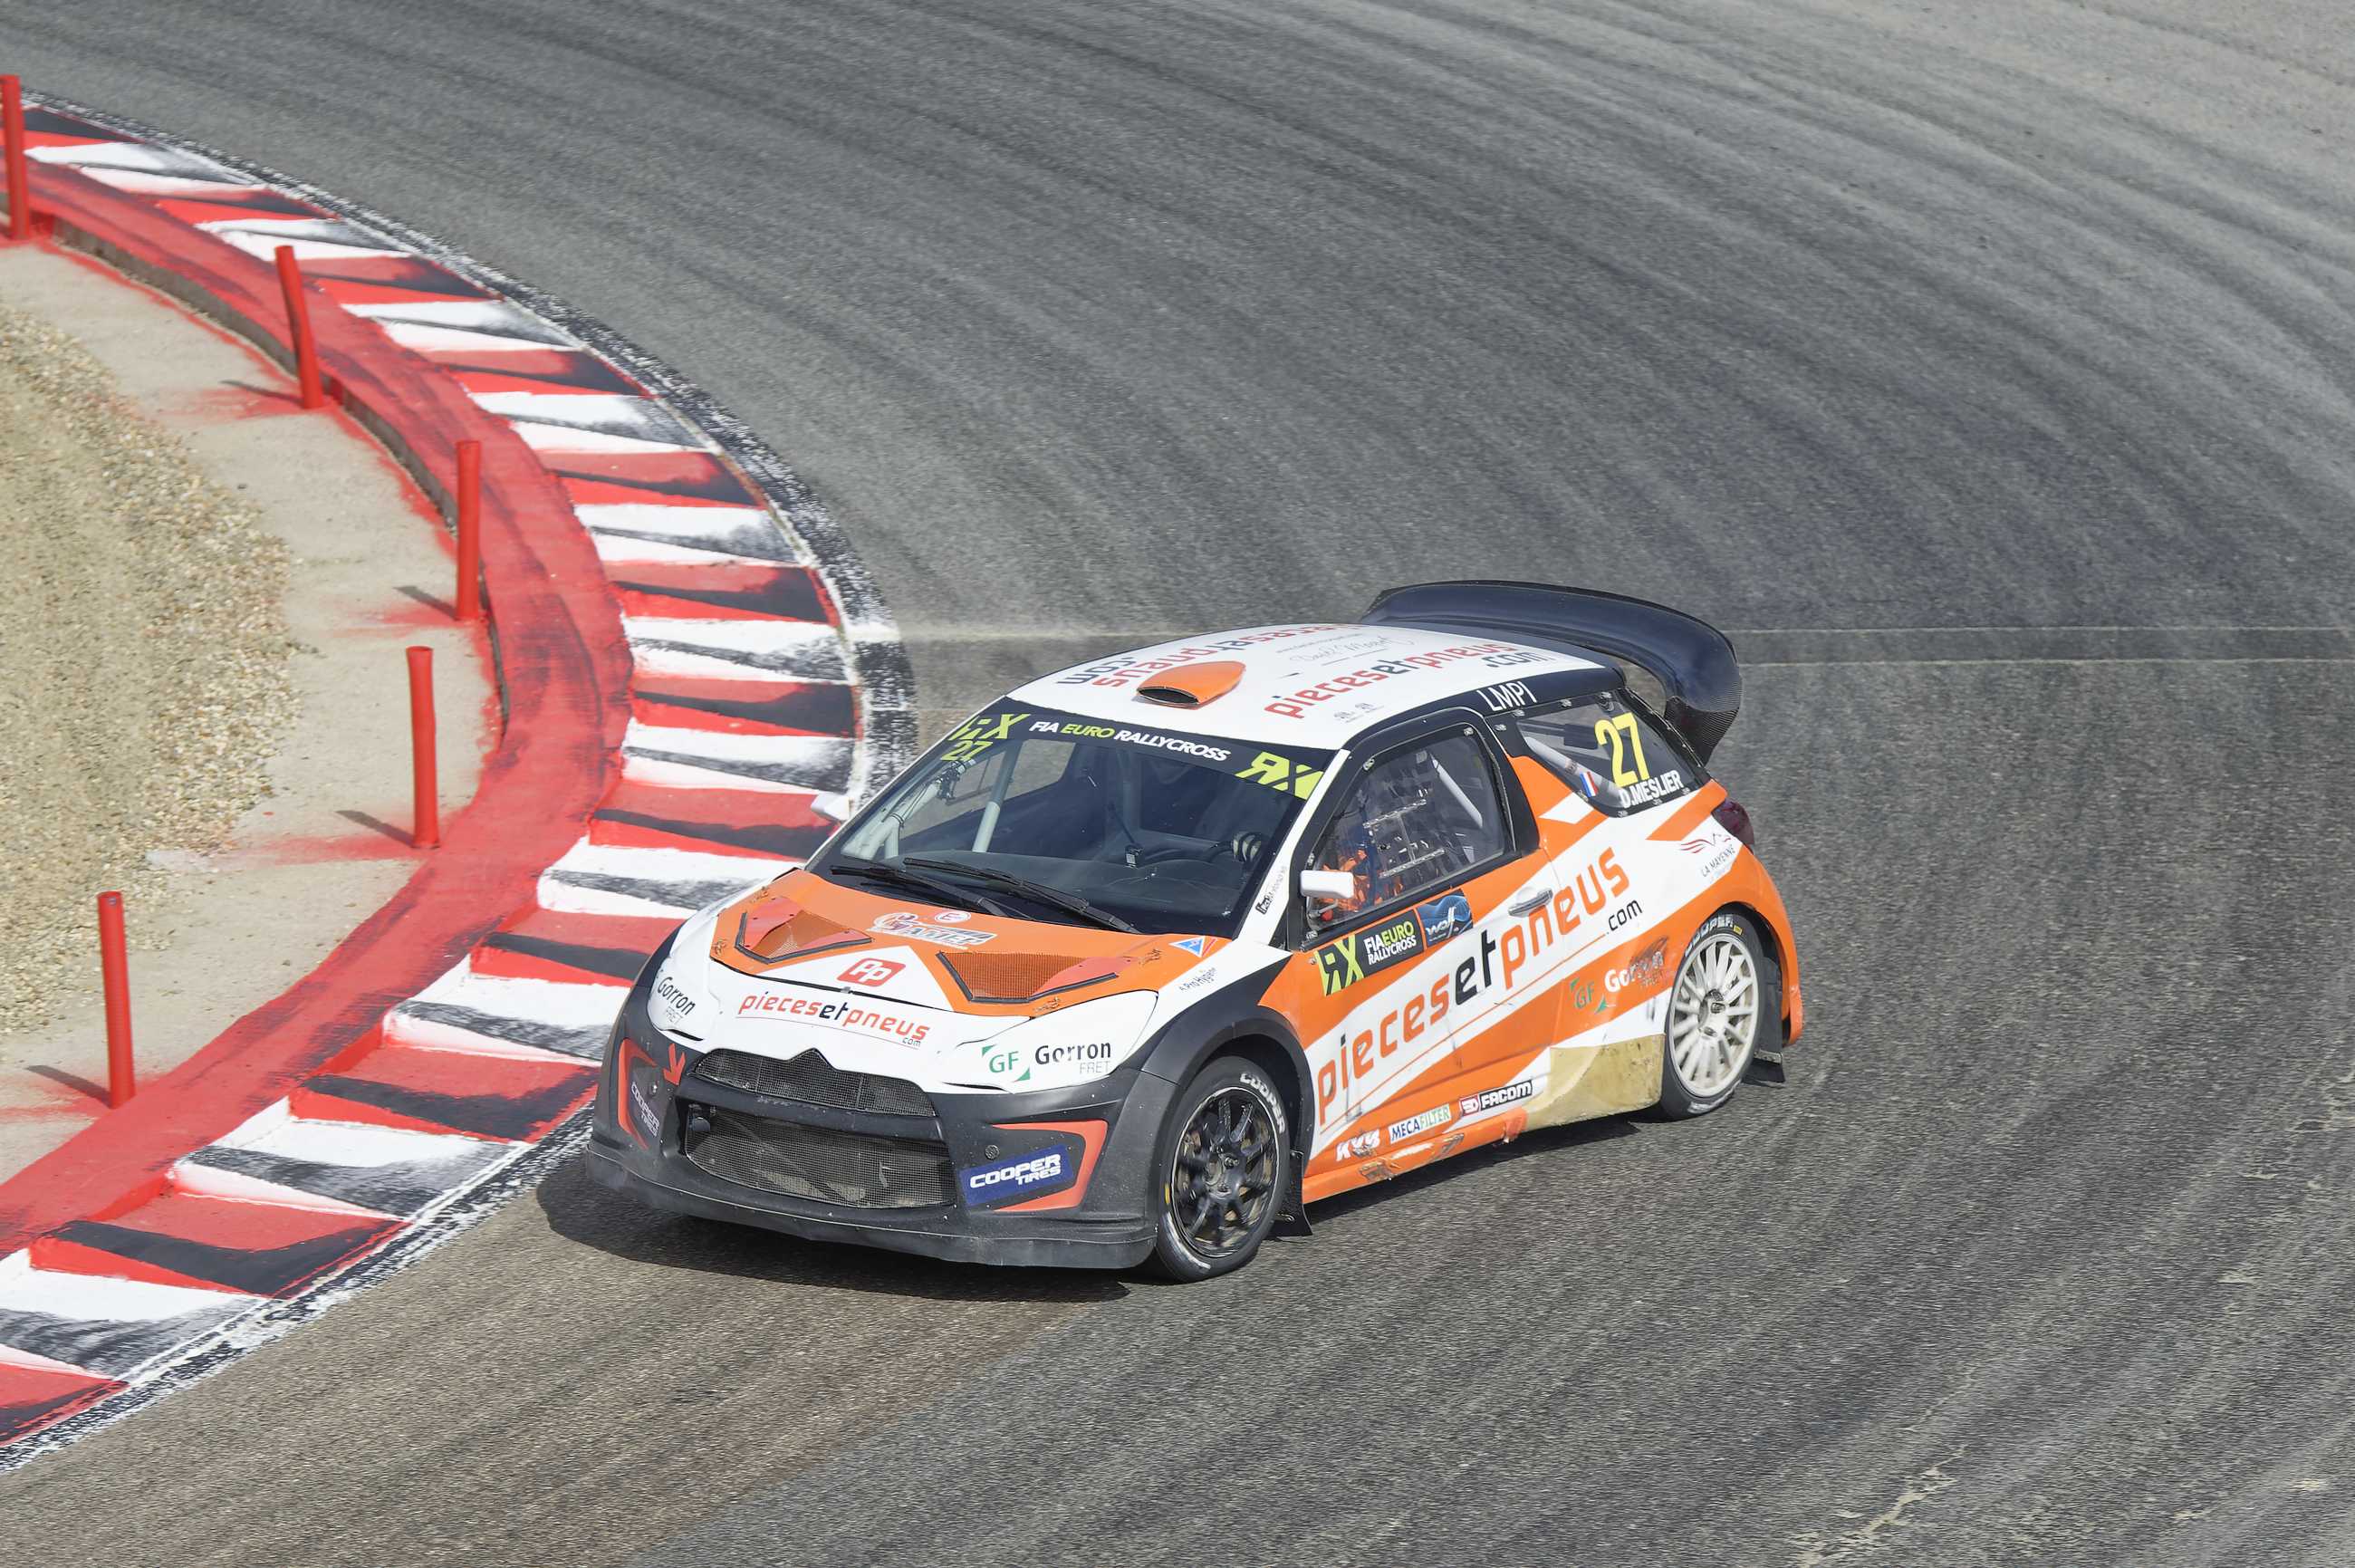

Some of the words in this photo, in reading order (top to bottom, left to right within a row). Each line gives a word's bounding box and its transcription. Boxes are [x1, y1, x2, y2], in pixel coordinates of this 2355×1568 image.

[1264, 643, 1518, 719] piecesetpneus
[1476, 679, 1537, 712] LMPI
[940, 740, 994, 761] 27
[1029, 721, 1060, 733] FIA
[1061, 724, 1115, 738] EURO
[1113, 729, 1232, 762] RALLYCROSS
[1594, 712, 1650, 788] 27
[1367, 935, 1418, 966] RALLYCROSS
[657, 976, 697, 1015] Gorron
[1317, 847, 1629, 1126] piecesetpneus
[738, 991, 930, 1042] piecesetpneus
[988, 1050, 1020, 1073] GF
[1034, 1042, 1111, 1065] Gorron
[1079, 1060, 1110, 1074] FRET
[631, 1081, 660, 1129] COOPER
[1240, 1072, 1286, 1134] COOPER
[1391, 1105, 1450, 1140] MECAFILTER
[969, 1153, 1062, 1188] COOPER
[1015, 1167, 1062, 1186] TIRES
